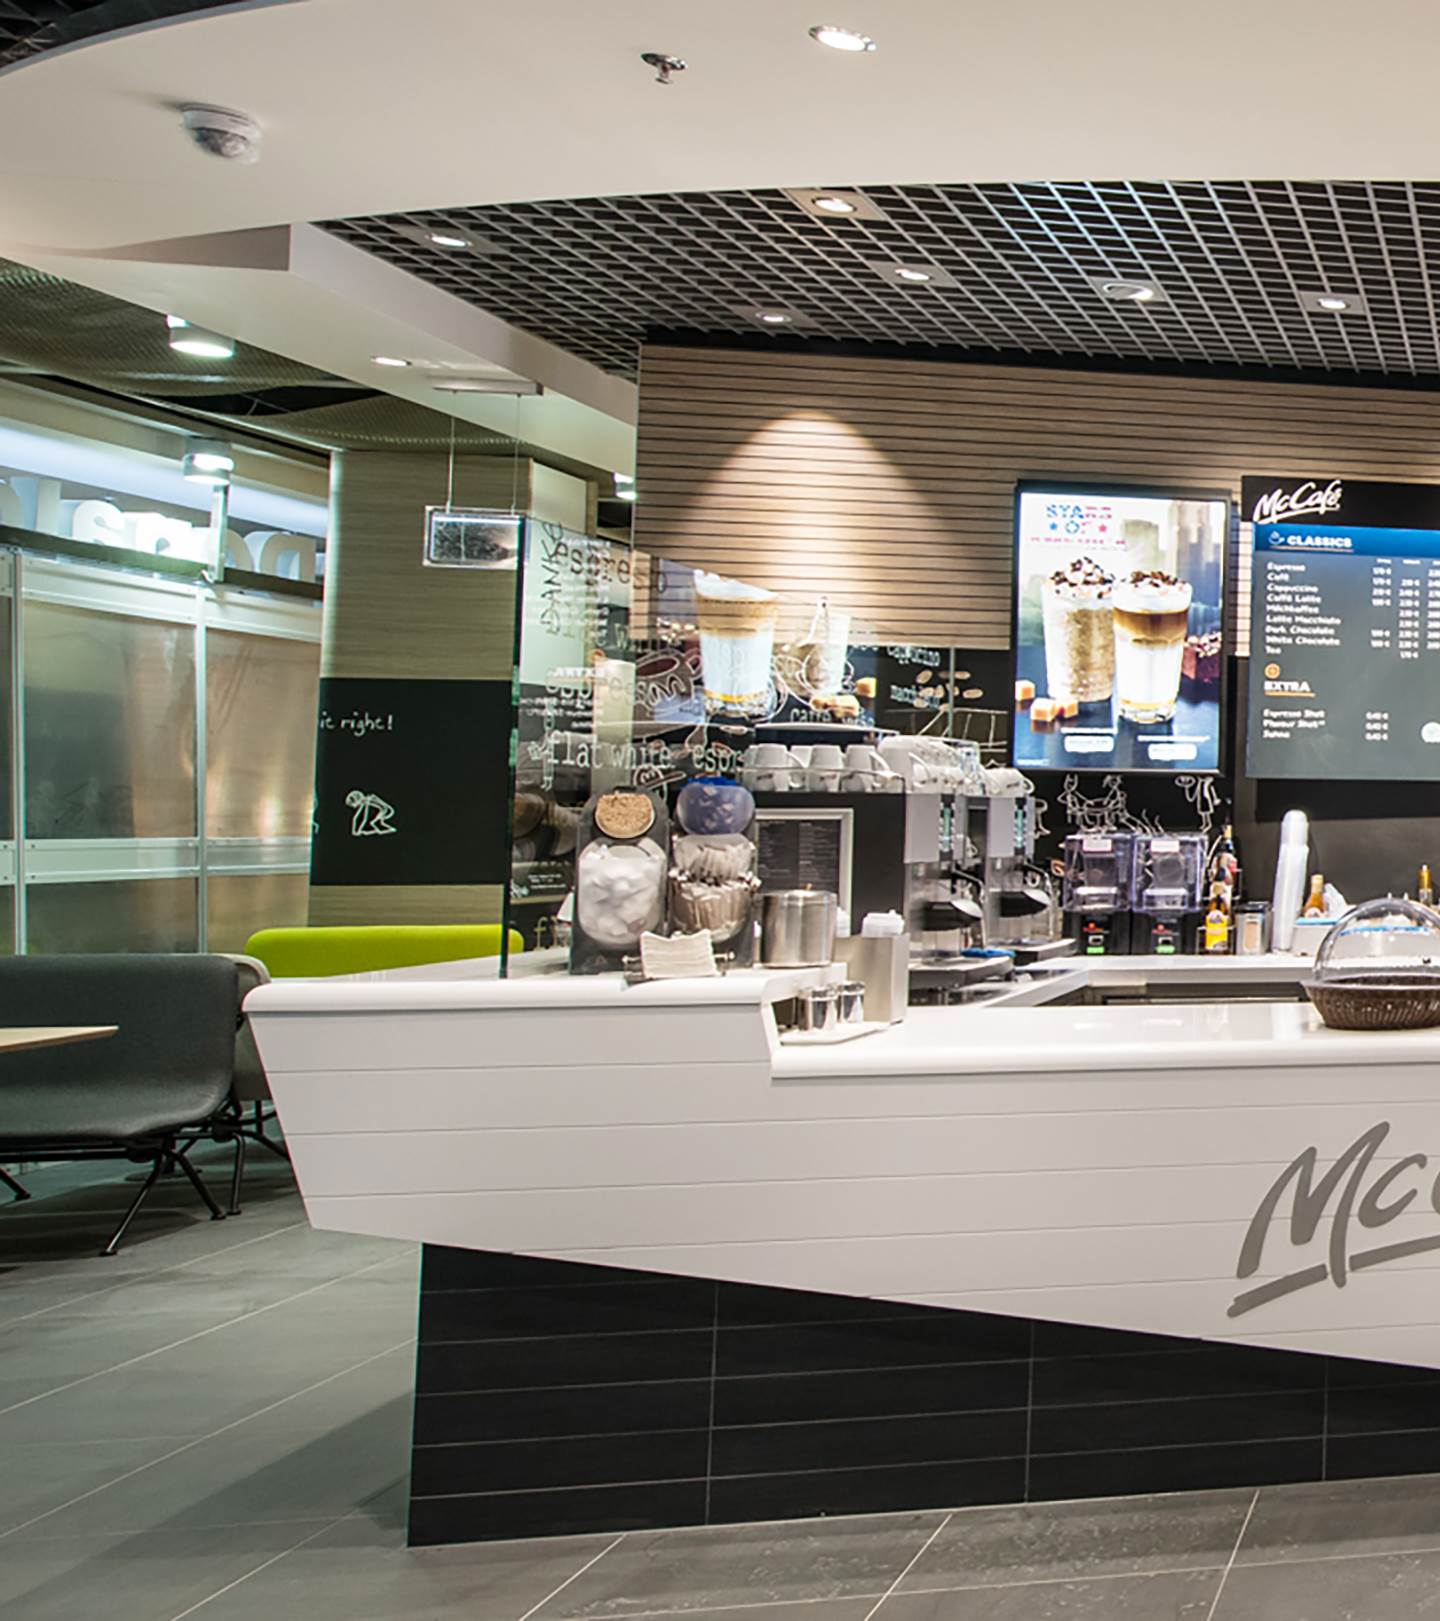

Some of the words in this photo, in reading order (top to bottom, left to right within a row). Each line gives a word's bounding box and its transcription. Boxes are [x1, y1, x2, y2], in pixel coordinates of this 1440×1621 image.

[1253, 480, 1342, 525] McCafé
[1287, 535, 1352, 549] CLASSICS
[1263, 680, 1311, 693] EXTRA
